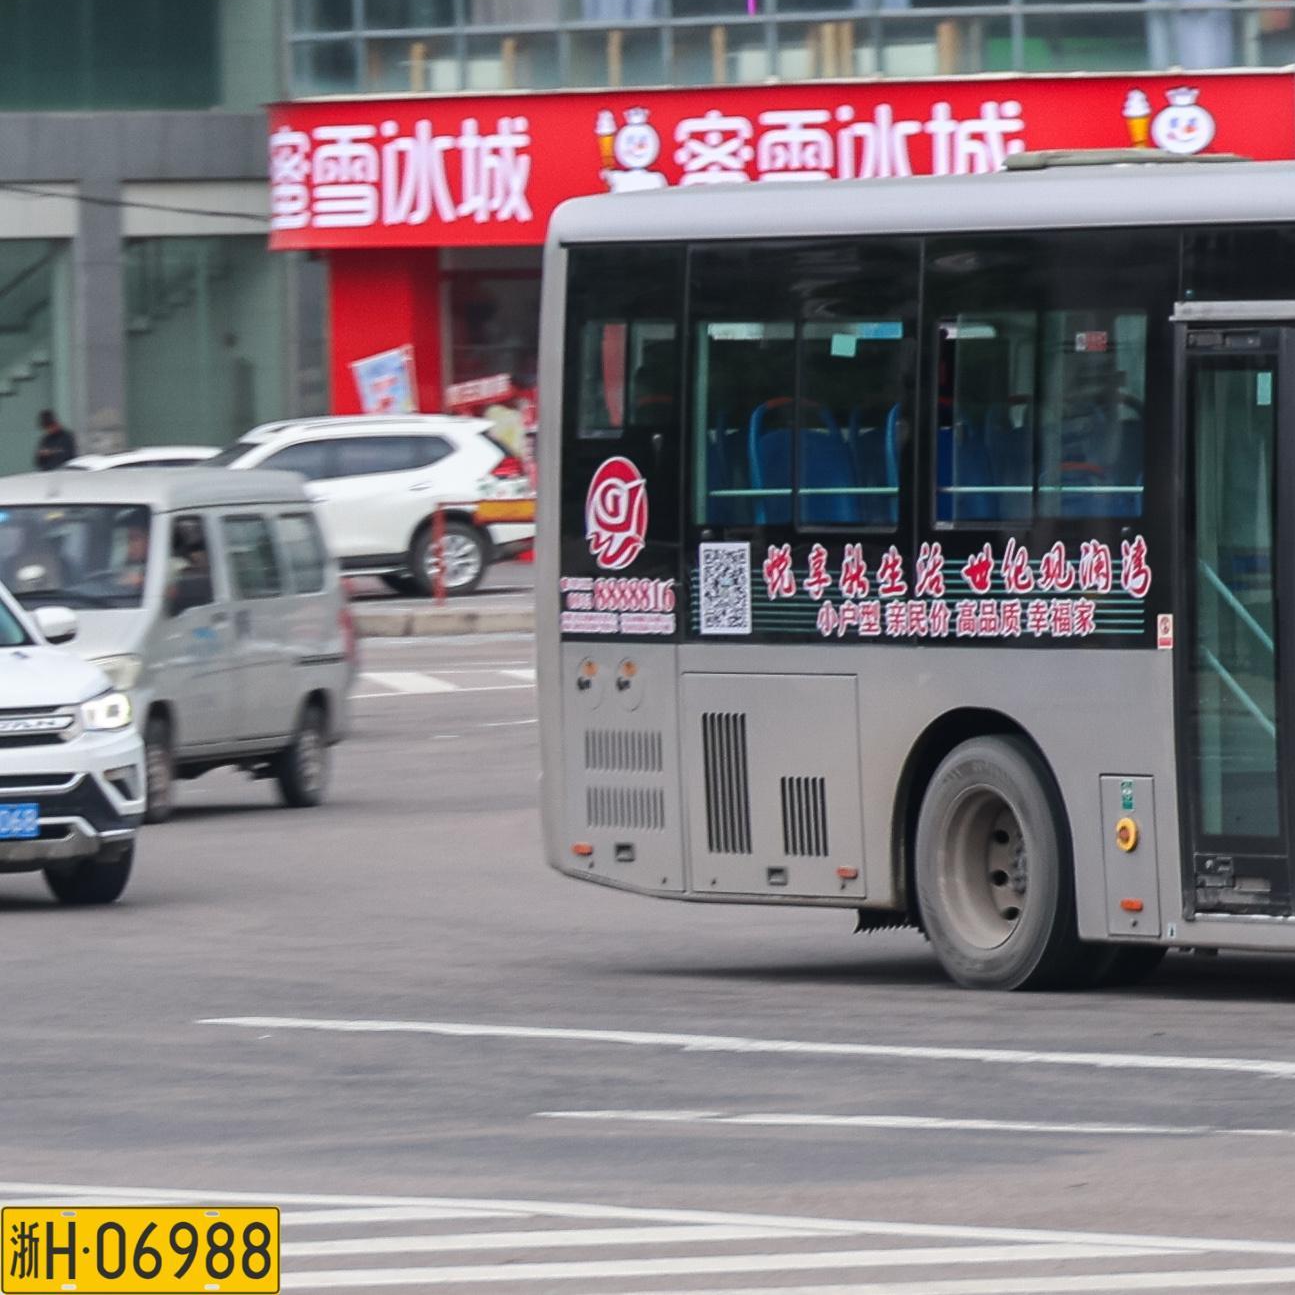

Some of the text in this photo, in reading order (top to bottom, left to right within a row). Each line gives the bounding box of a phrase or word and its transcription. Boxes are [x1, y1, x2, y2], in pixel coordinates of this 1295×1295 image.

[817, 597, 1097, 637] 小户型 亲民价 高品质 幸福家
